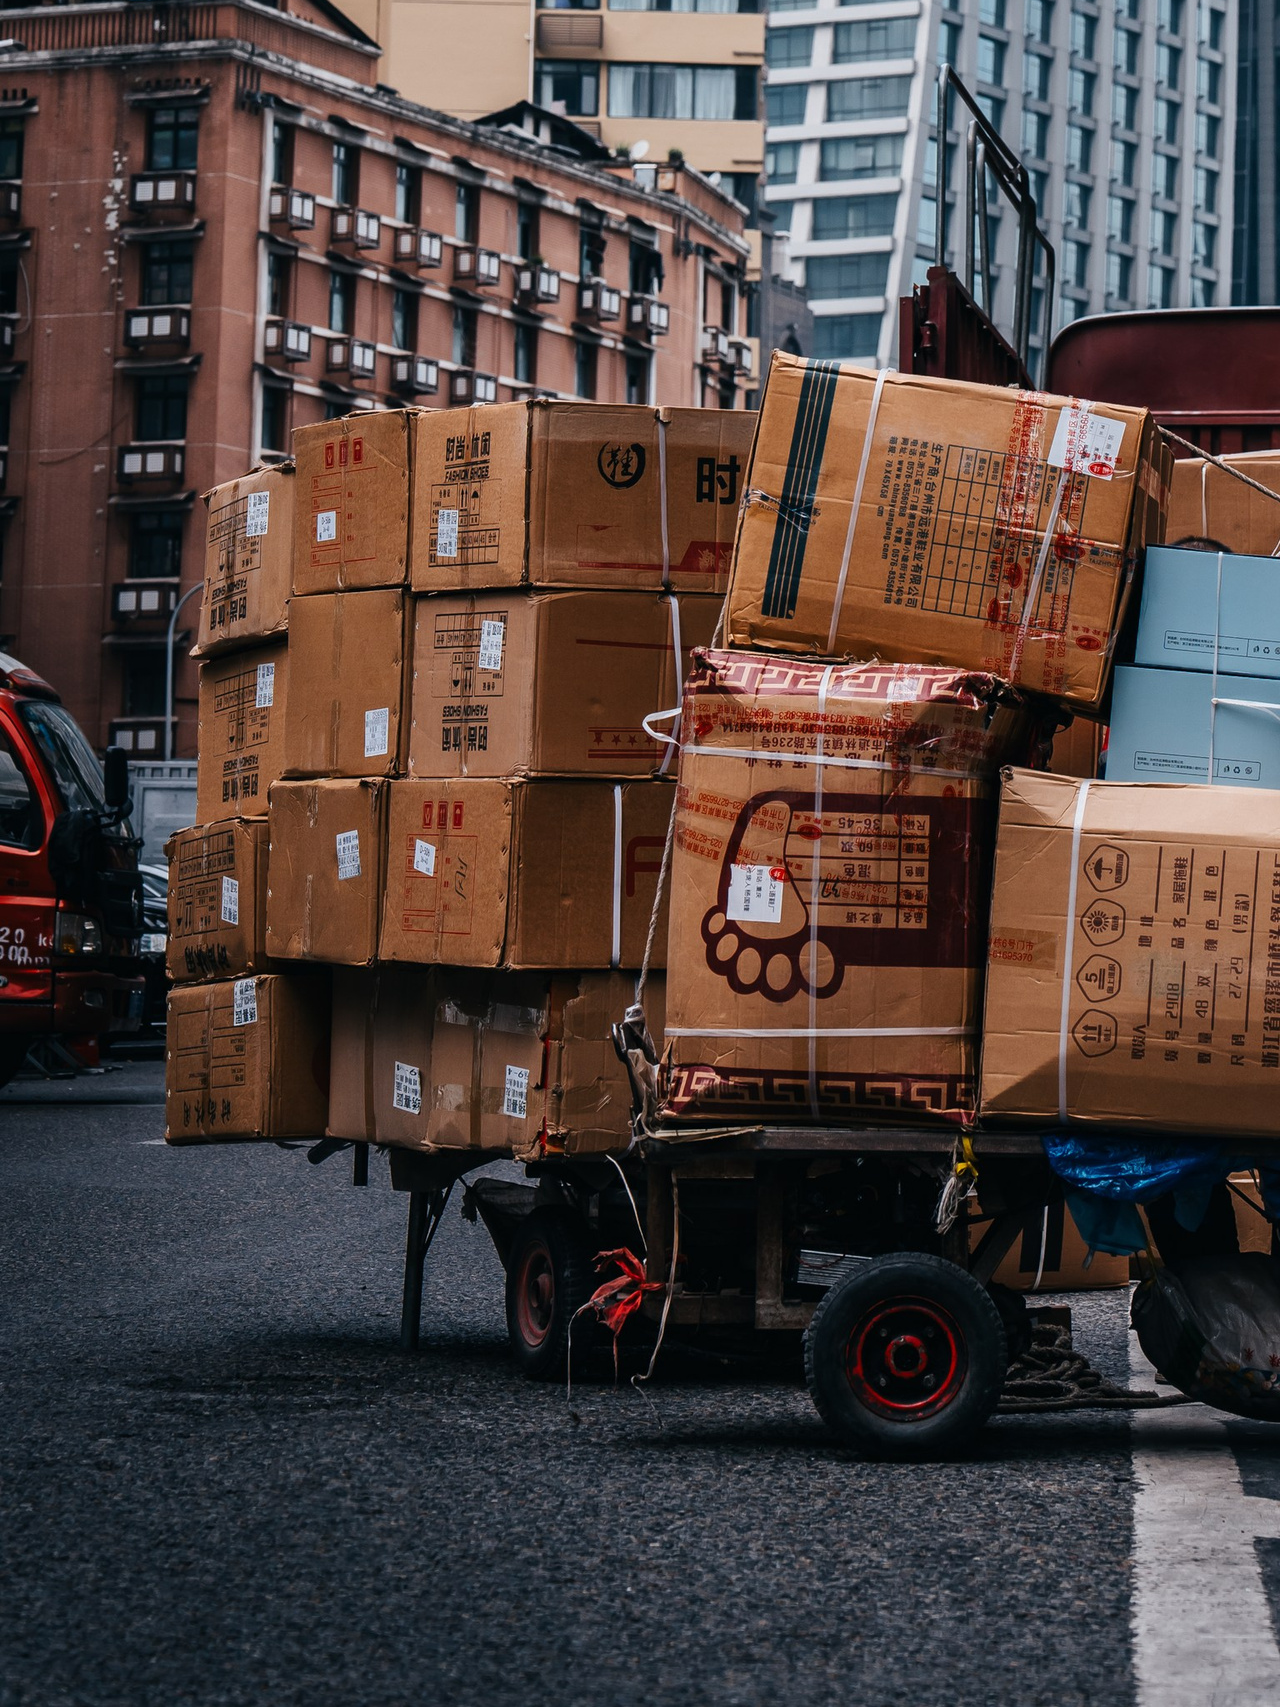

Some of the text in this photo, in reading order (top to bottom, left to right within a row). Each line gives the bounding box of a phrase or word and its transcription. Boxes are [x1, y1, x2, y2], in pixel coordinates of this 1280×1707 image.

[444, 465, 490, 483] FASHION SHOES
[696, 455, 741, 505] 时
[442, 704, 488, 718] FASHION SHOES
[838, 817, 881, 830] 36-45
[842, 863, 926, 878] 颜色 混色
[902, 911, 924, 924] 品名
[1164, 983, 1180, 1020] 2908
[1172, 856, 1189, 904] 家居拖鞋
[1085, 972, 1098, 983] 5
[1228, 956, 1244, 1000] 27-29
[1195, 1000, 1210, 1019] 48
[1131, 1024, 1147, 1060] 收货人
